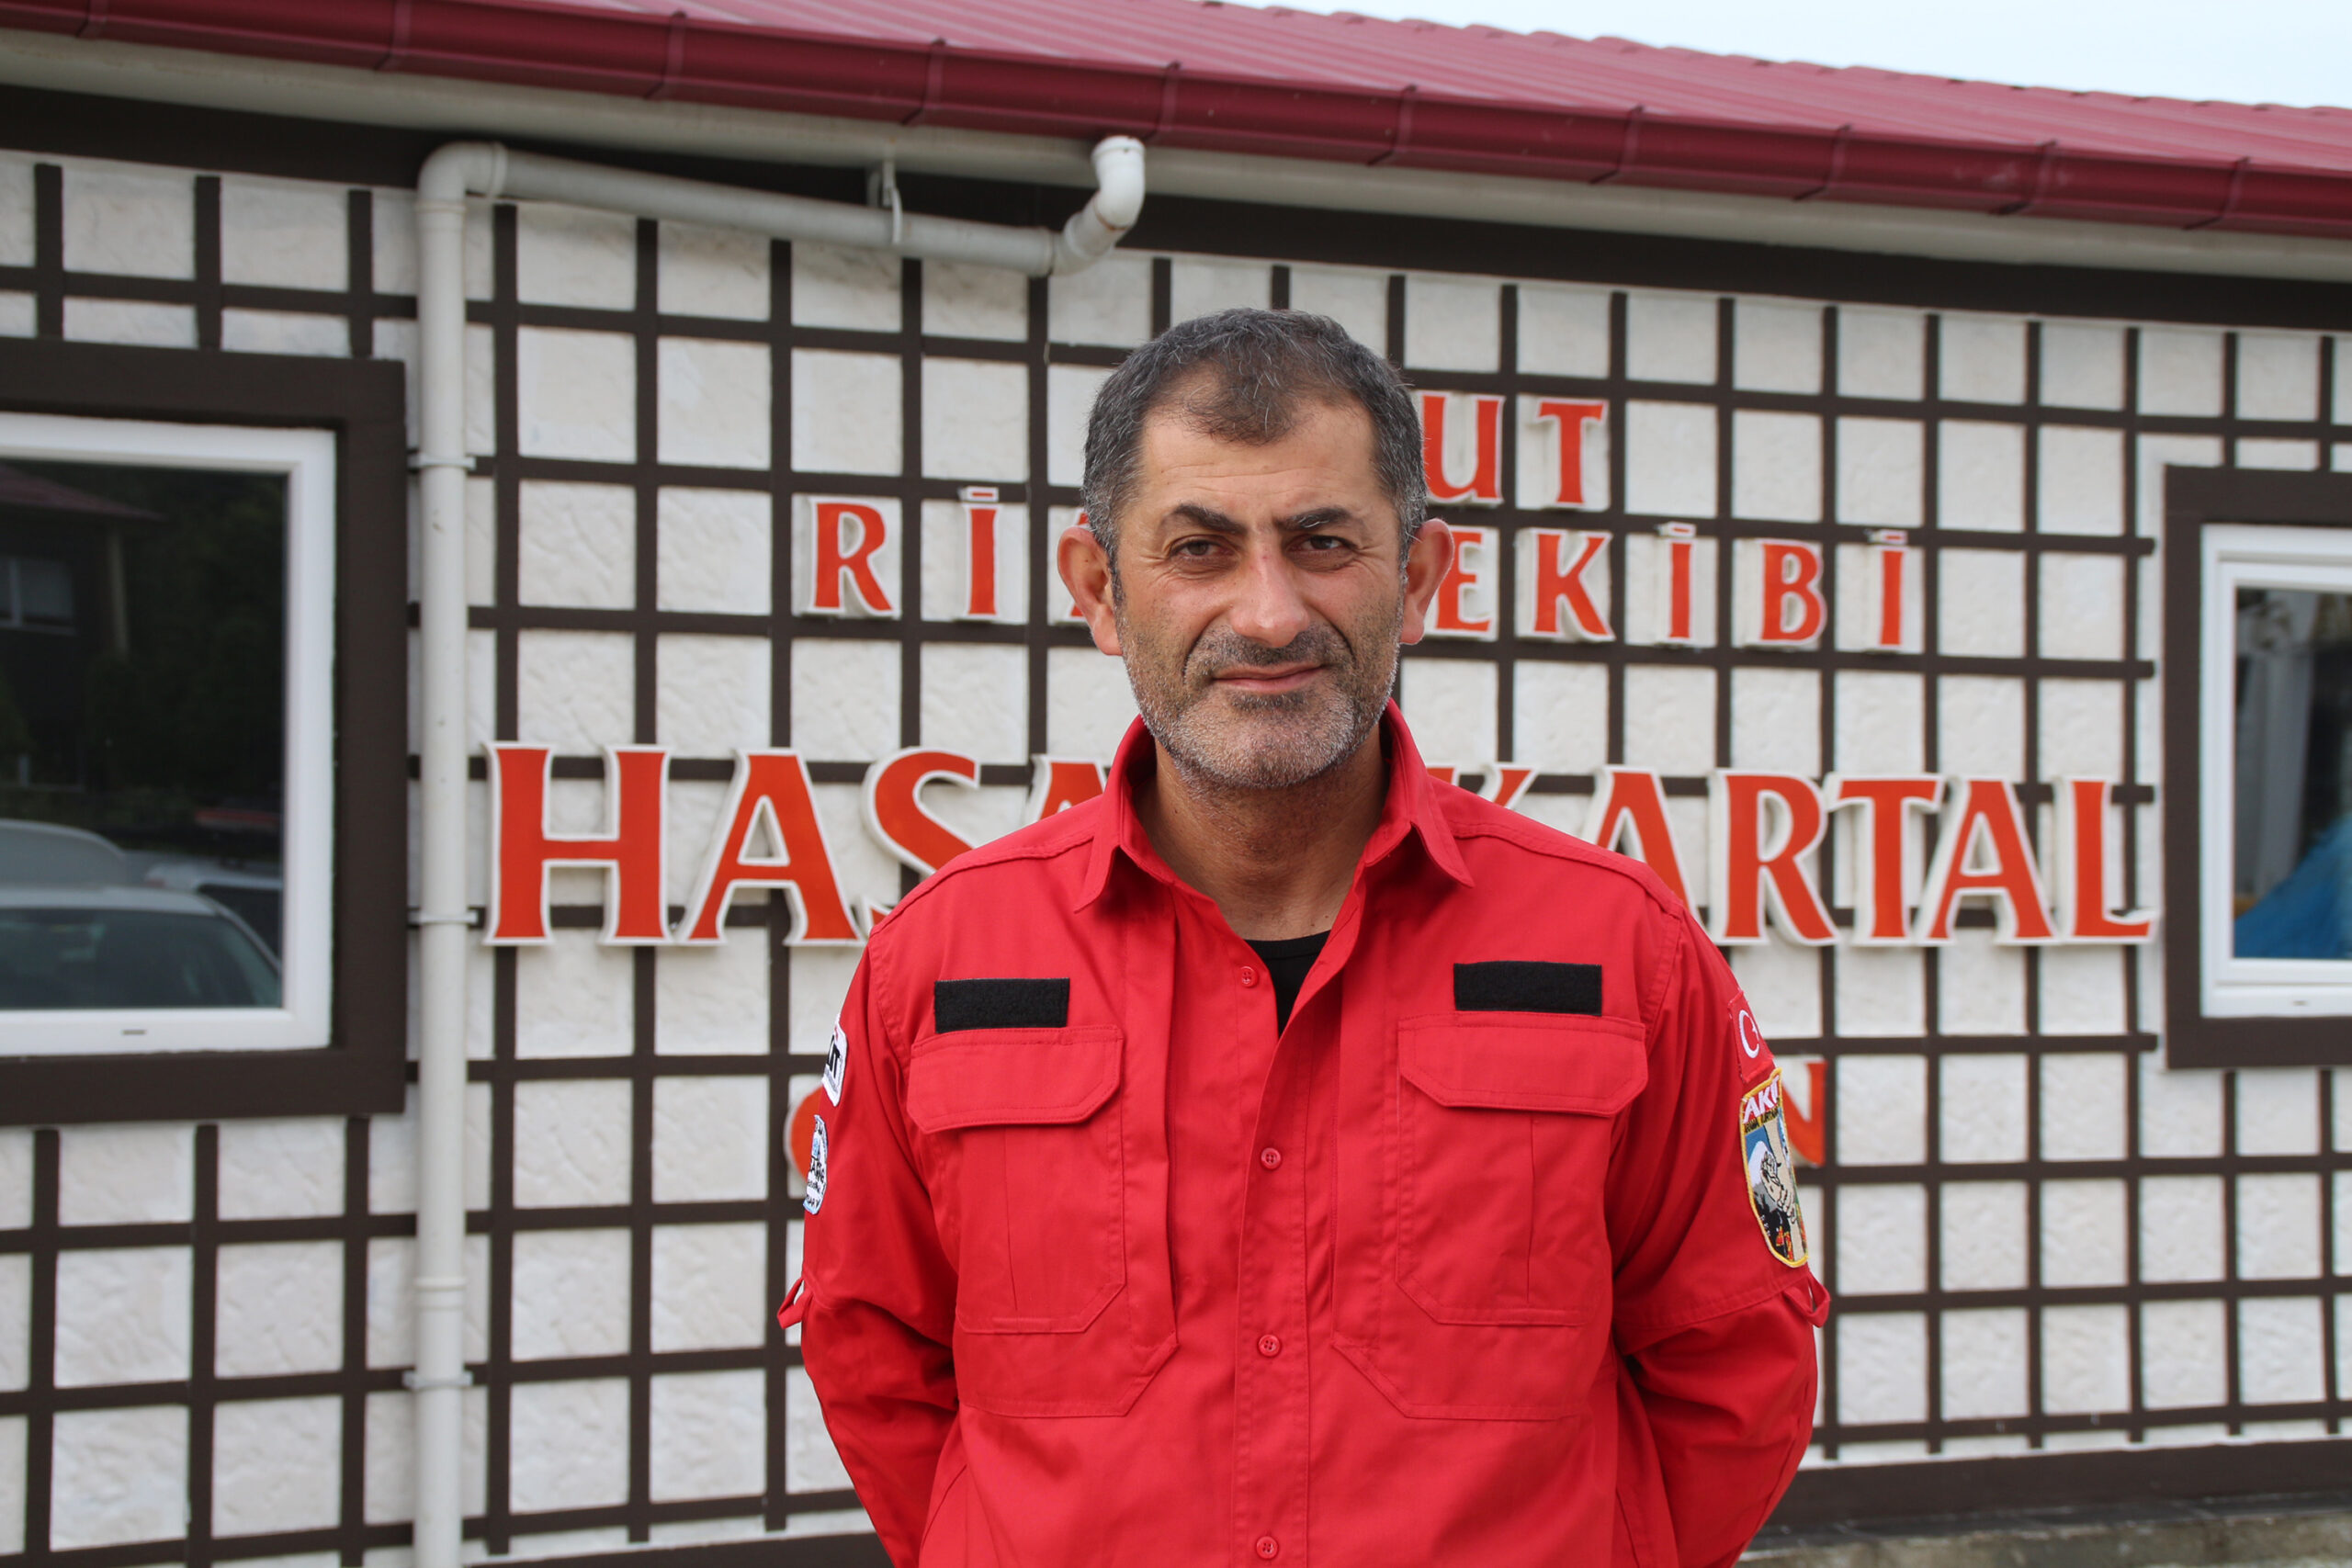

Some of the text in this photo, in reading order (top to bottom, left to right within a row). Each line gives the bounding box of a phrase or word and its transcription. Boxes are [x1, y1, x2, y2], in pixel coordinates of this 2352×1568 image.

[810, 487, 1088, 616] Rİ
[484, 743, 2160, 946] HAS ARTAL
